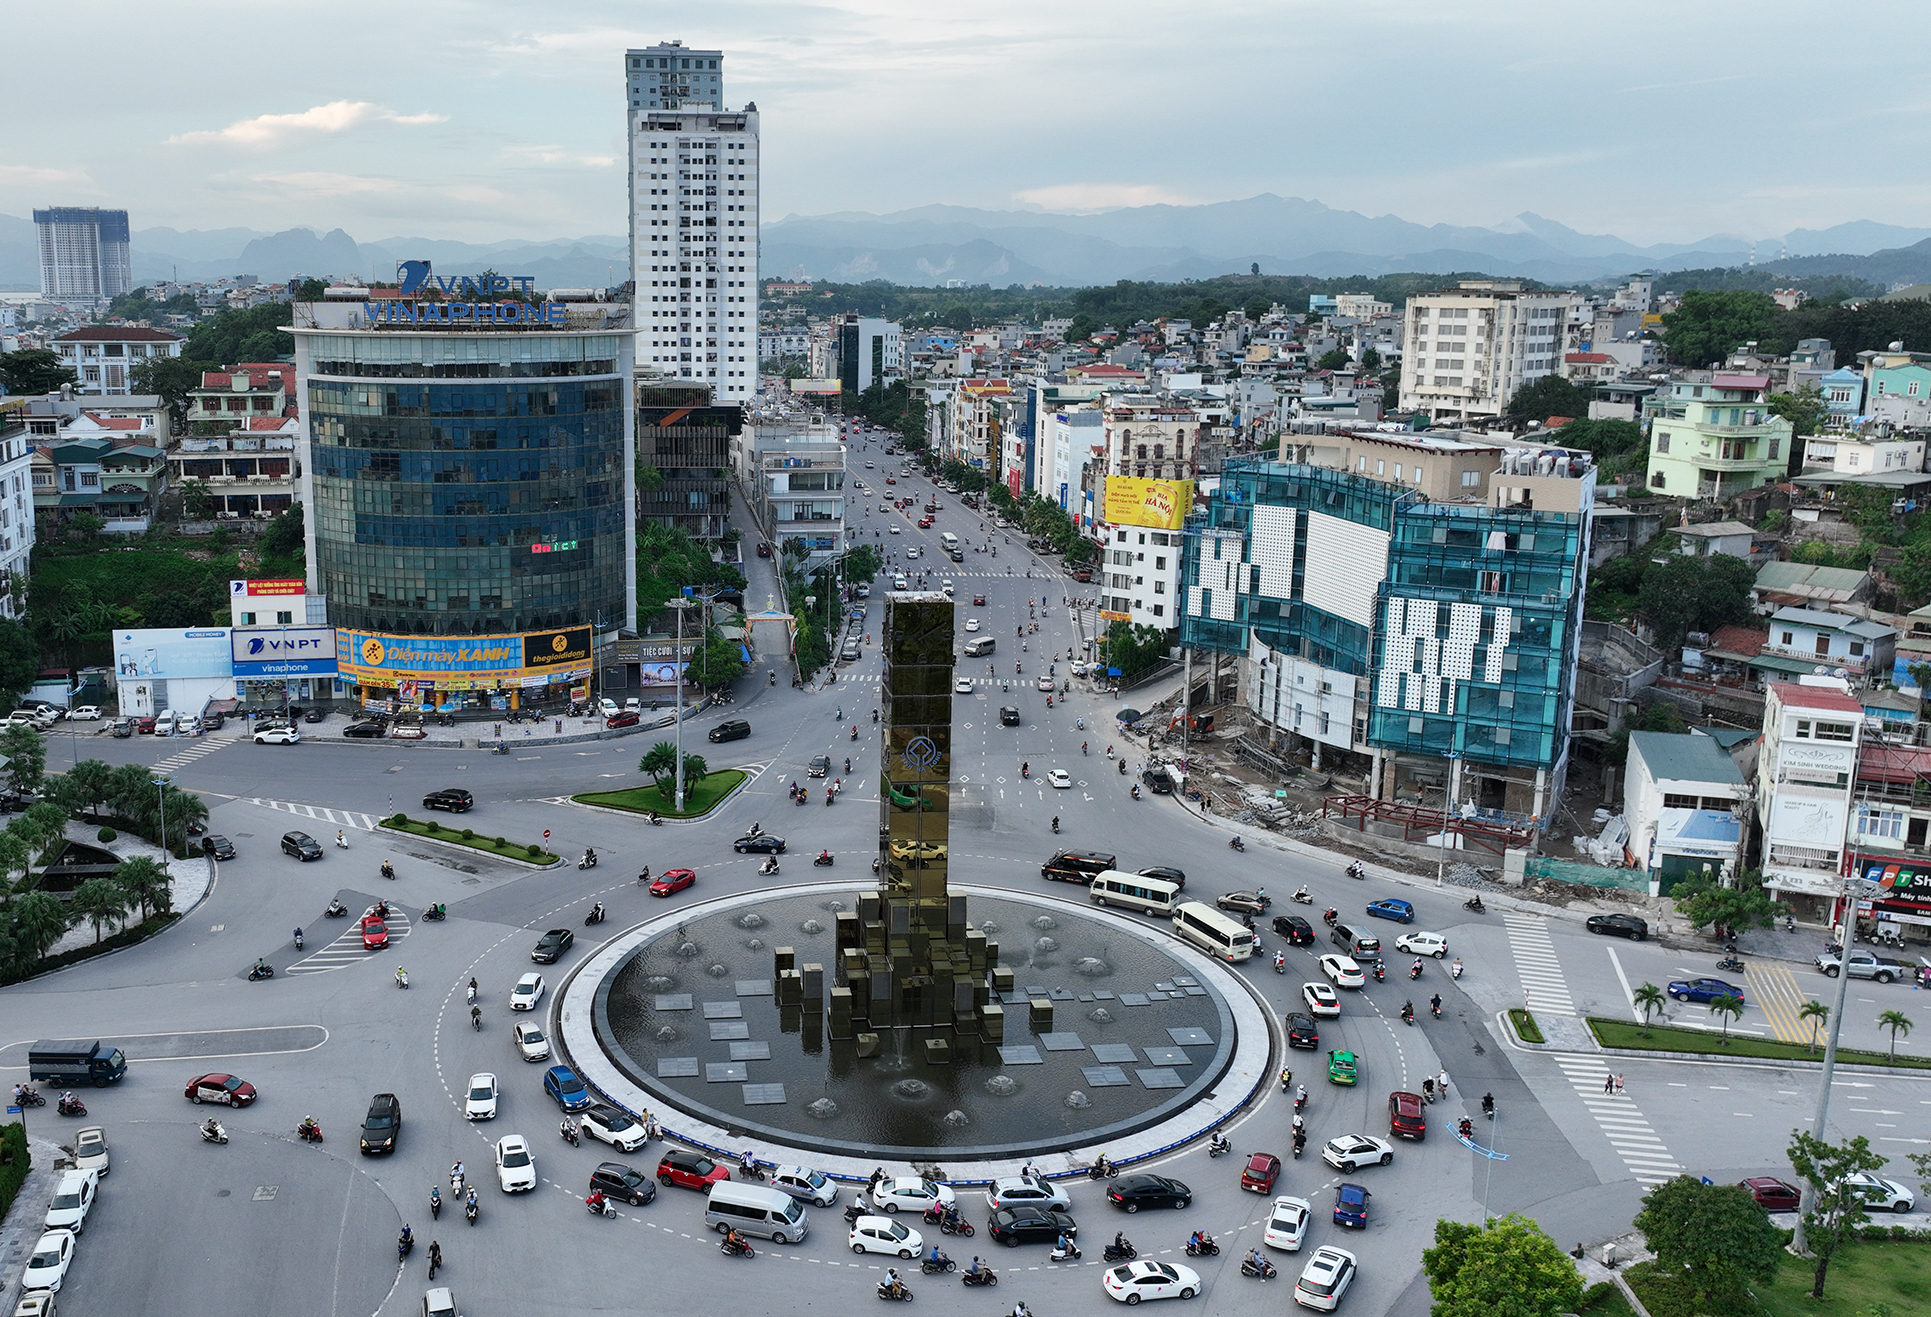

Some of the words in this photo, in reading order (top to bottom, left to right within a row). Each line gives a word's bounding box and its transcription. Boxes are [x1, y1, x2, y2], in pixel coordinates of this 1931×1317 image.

[436, 276, 535, 296] VNPT
[363, 302, 567, 323] VINAPHONE
[1157, 492, 1168, 501] BIA
[1145, 496, 1157, 507] HÀ
[1158, 501, 1173, 516] NỘI
[269, 639, 321, 649] VNPT
[387, 647, 420, 664] Điện
[423, 648, 457, 665] máy
[456, 647, 510, 662] XANH
[532, 650, 585, 663] thegioididong
[643, 646, 657, 657] TIỆC
[658, 645, 673, 656] CƯỚI
[262, 664, 308, 673] vinaphone
[1815, 763, 1847, 771] WEDDING
[1867, 869, 1912, 885] FPT
